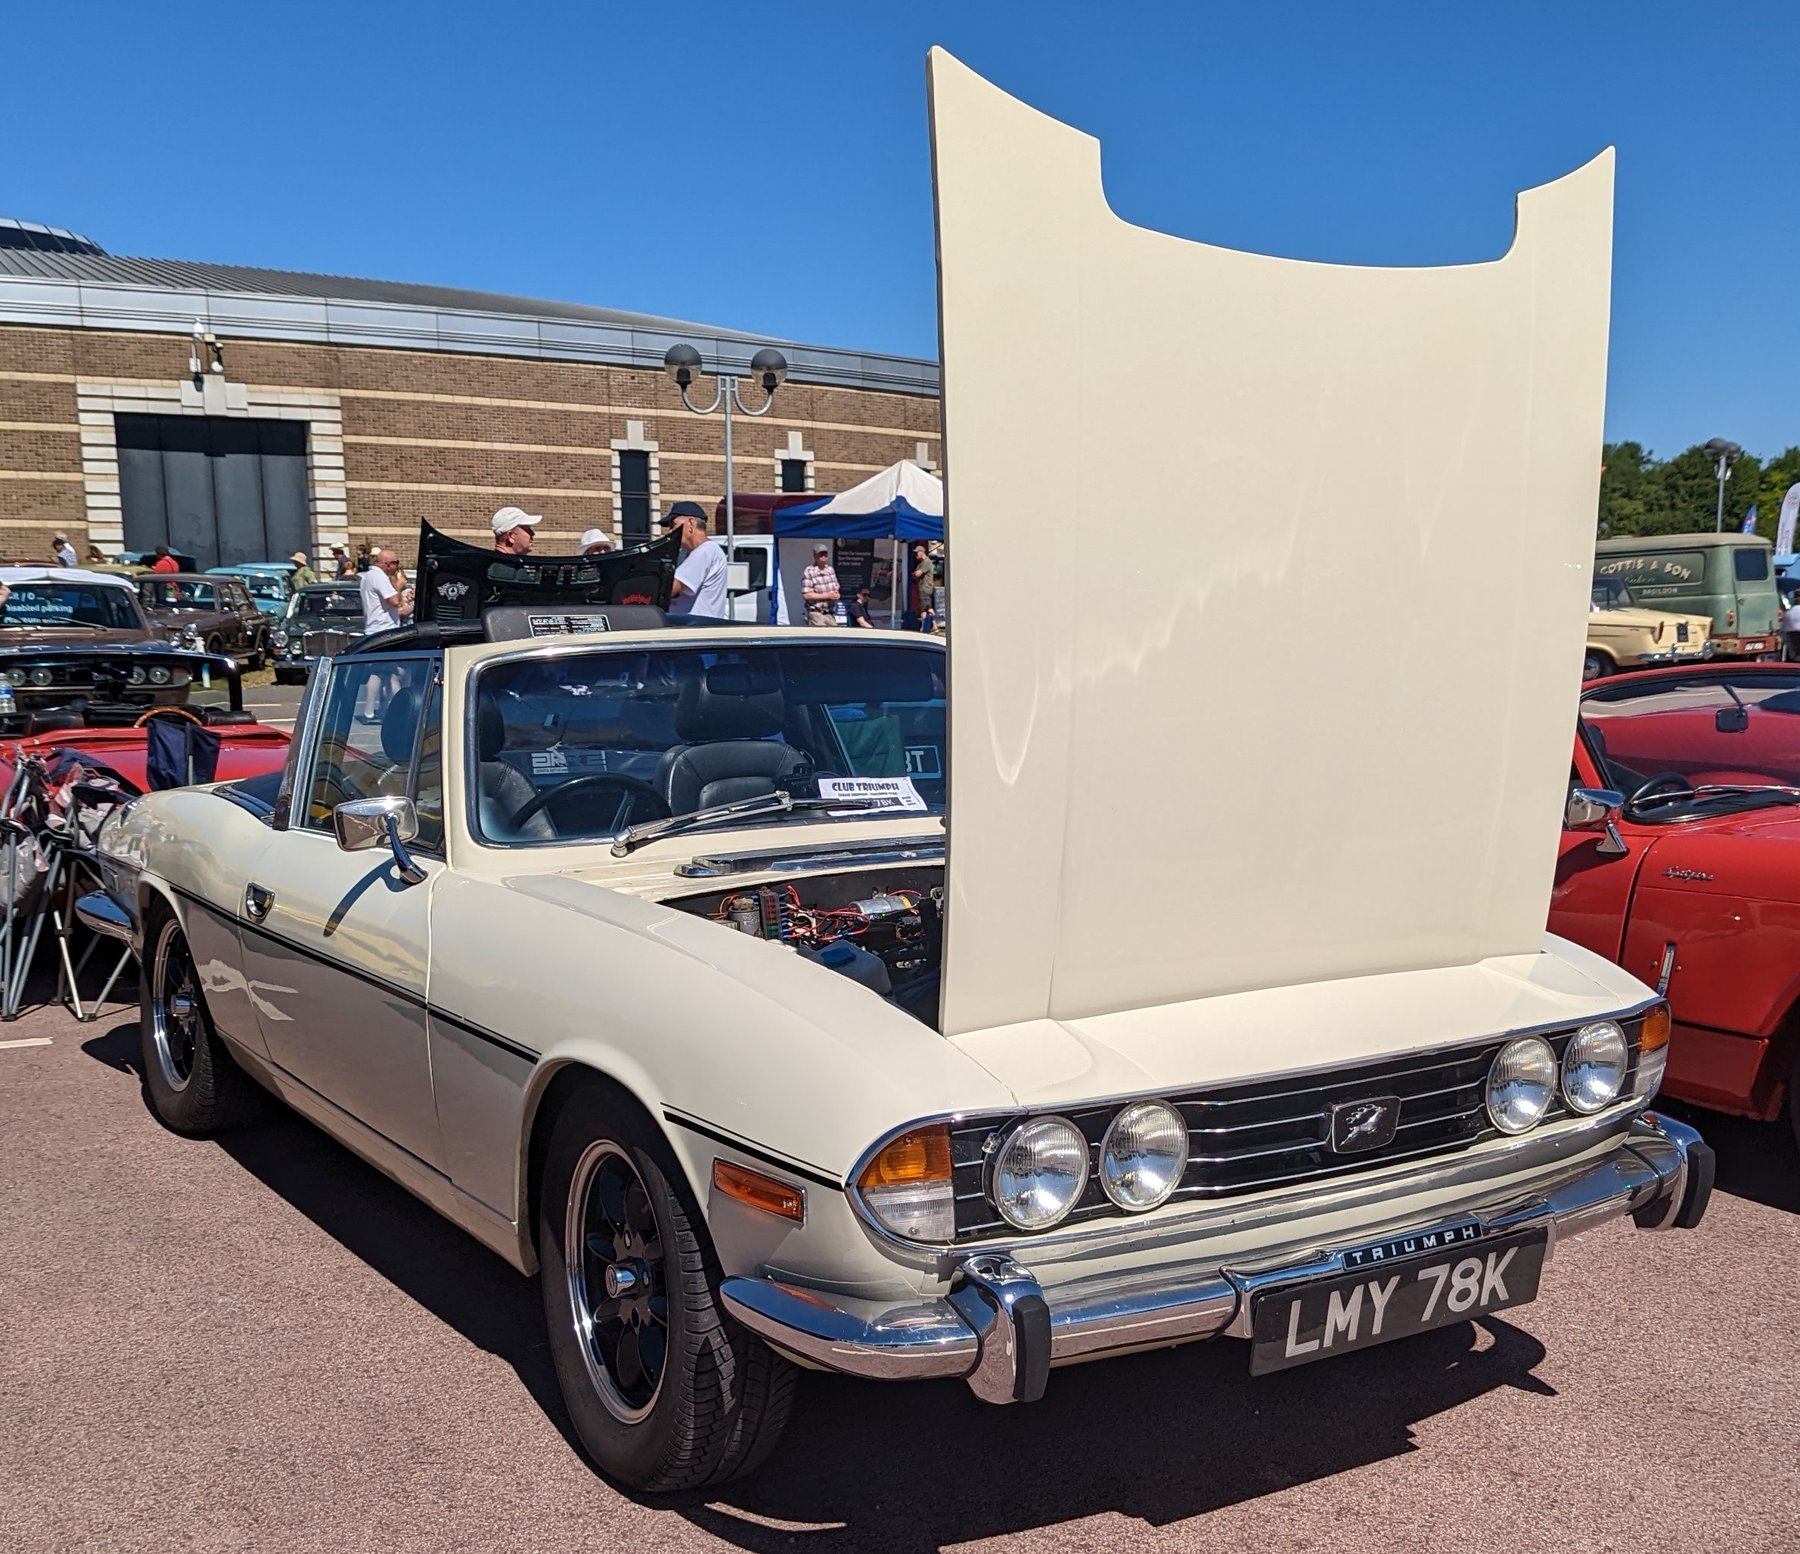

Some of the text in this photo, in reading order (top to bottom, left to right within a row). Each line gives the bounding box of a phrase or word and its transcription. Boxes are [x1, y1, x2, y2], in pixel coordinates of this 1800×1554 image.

[832, 782, 900, 791] CLUB TRIUMPH
[1352, 1226, 1475, 1264] TRIUMPH
[1285, 1246, 1519, 1358] LMY 78K
